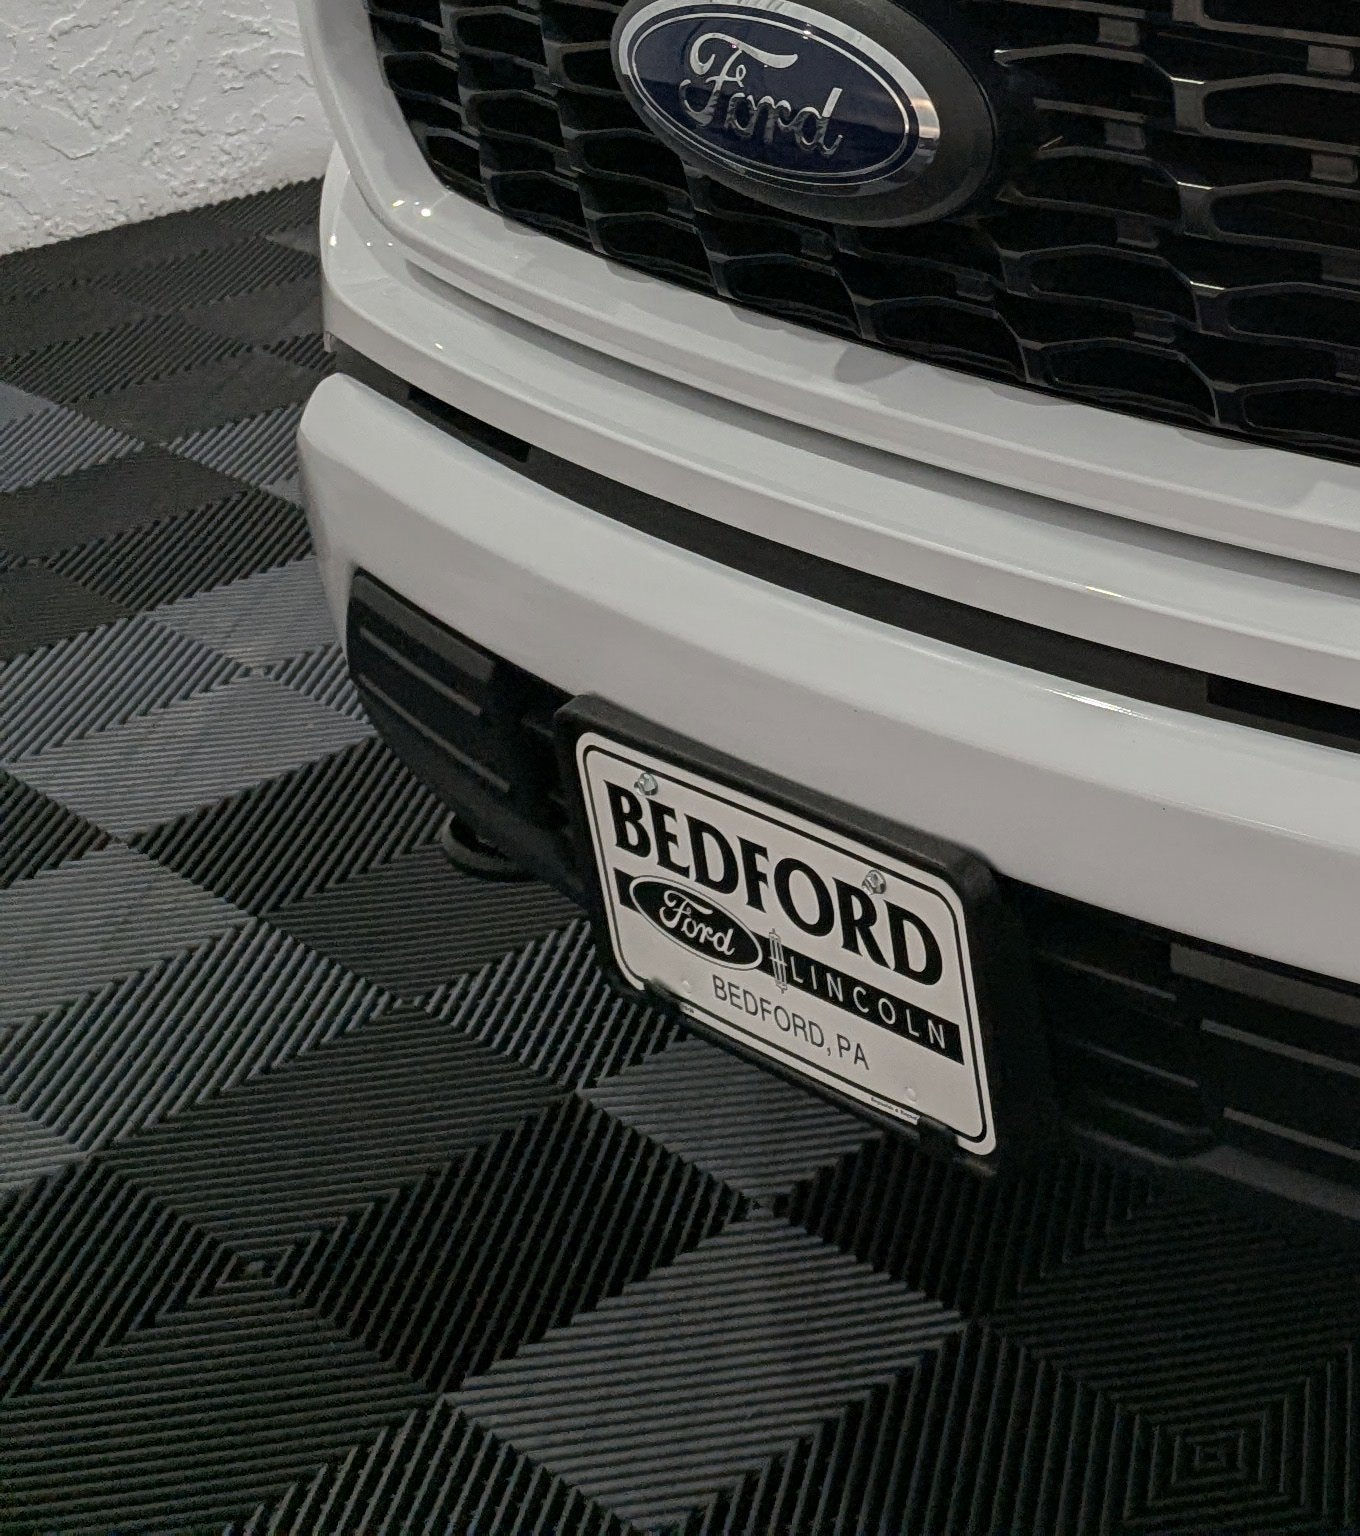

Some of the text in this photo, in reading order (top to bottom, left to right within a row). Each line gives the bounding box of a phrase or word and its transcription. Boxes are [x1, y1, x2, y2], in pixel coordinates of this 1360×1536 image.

[678, 31, 843, 157] Ford
[603, 779, 943, 986] BEDFORD
[658, 889, 947, 1050] Ford LINCOLN
[712, 974, 871, 1070] BEDFORD, PA
